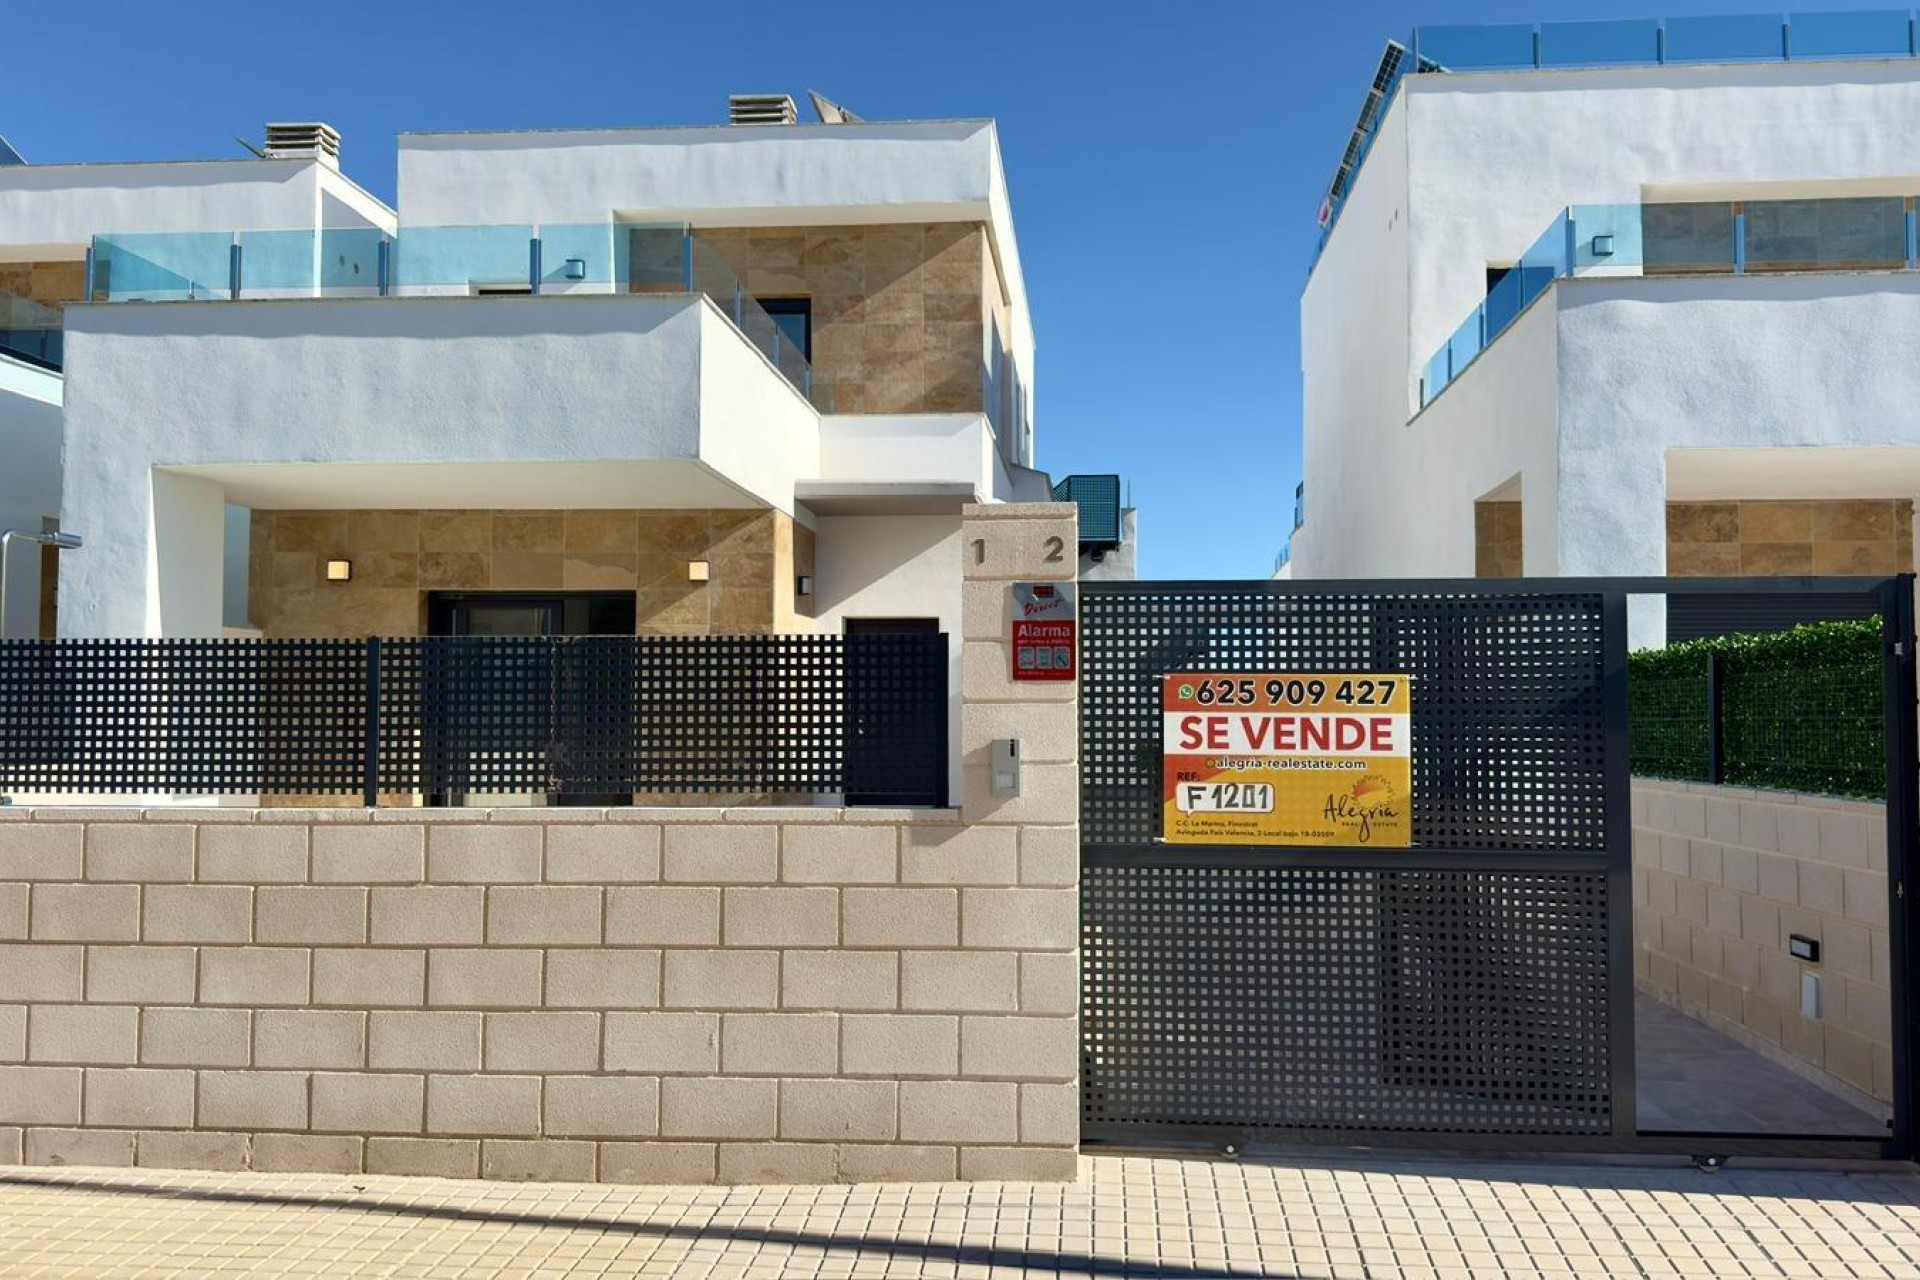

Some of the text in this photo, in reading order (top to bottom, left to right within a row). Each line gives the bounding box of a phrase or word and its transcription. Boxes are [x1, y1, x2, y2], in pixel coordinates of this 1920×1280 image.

[971, 538, 985, 565] 1
[1043, 535, 1064, 562] 2
[1018, 624, 1071, 637] Alarma
[1196, 679, 1395, 706] 625 909 427
[1179, 716, 1394, 751] SE VENDE
[1177, 772, 1201, 782] REF:
[1216, 758, 1367, 772] alegria-realestate.com
[1323, 794, 1399, 842] Alegria
